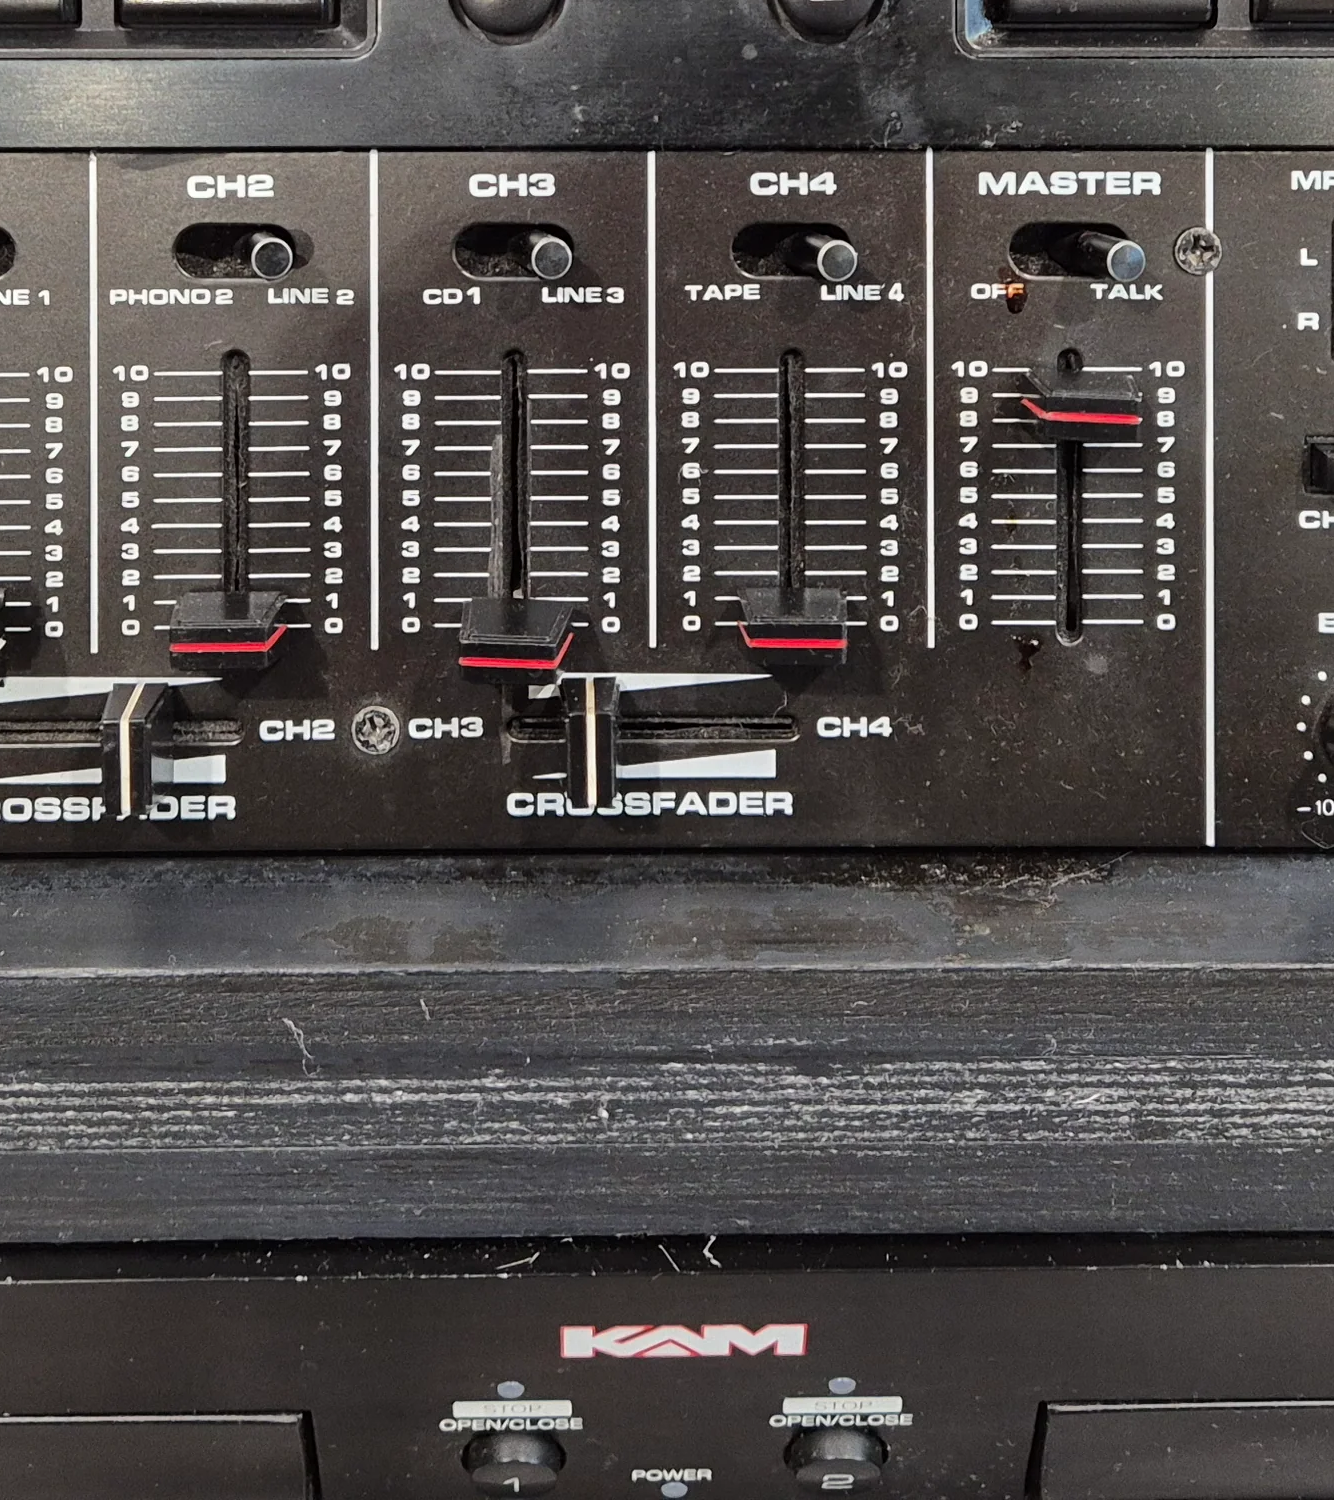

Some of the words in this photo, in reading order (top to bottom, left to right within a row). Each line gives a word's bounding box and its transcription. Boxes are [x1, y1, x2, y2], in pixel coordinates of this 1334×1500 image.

[186, 174, 275, 199] CH2
[468, 173, 556, 198] CH3
[749, 171, 838, 196] CH4
[978, 171, 1162, 196] MASTER
[1300, 247, 1319, 266] L
[38, 289, 50, 306] 1
[109, 288, 212, 306] PHONO
[214, 288, 234, 305] 2
[267, 287, 329, 305] LINE
[336, 289, 355, 305] 2
[541, 286, 603, 304] LINE
[606, 286, 625, 304] 3
[684, 283, 761, 302] TAPE
[820, 283, 886, 301] LINE
[888, 282, 905, 302] 4
[971, 283, 1025, 300] OFF
[1089, 283, 1164, 301] TALK
[1297, 312, 1320, 331] R
[259, 718, 336, 741] CH2
[407, 716, 484, 739] CH3
[816, 716, 893, 738] CH4
[560, 1323, 807, 1358] KAM
[438, 1417, 583, 1432] OPEN/CLOSE
[769, 1414, 913, 1428] OPEN/CLOSE
[502, 1476, 520, 1493] 1
[631, 1468, 713, 1482] POWER
[821, 1473, 855, 1490] 2
